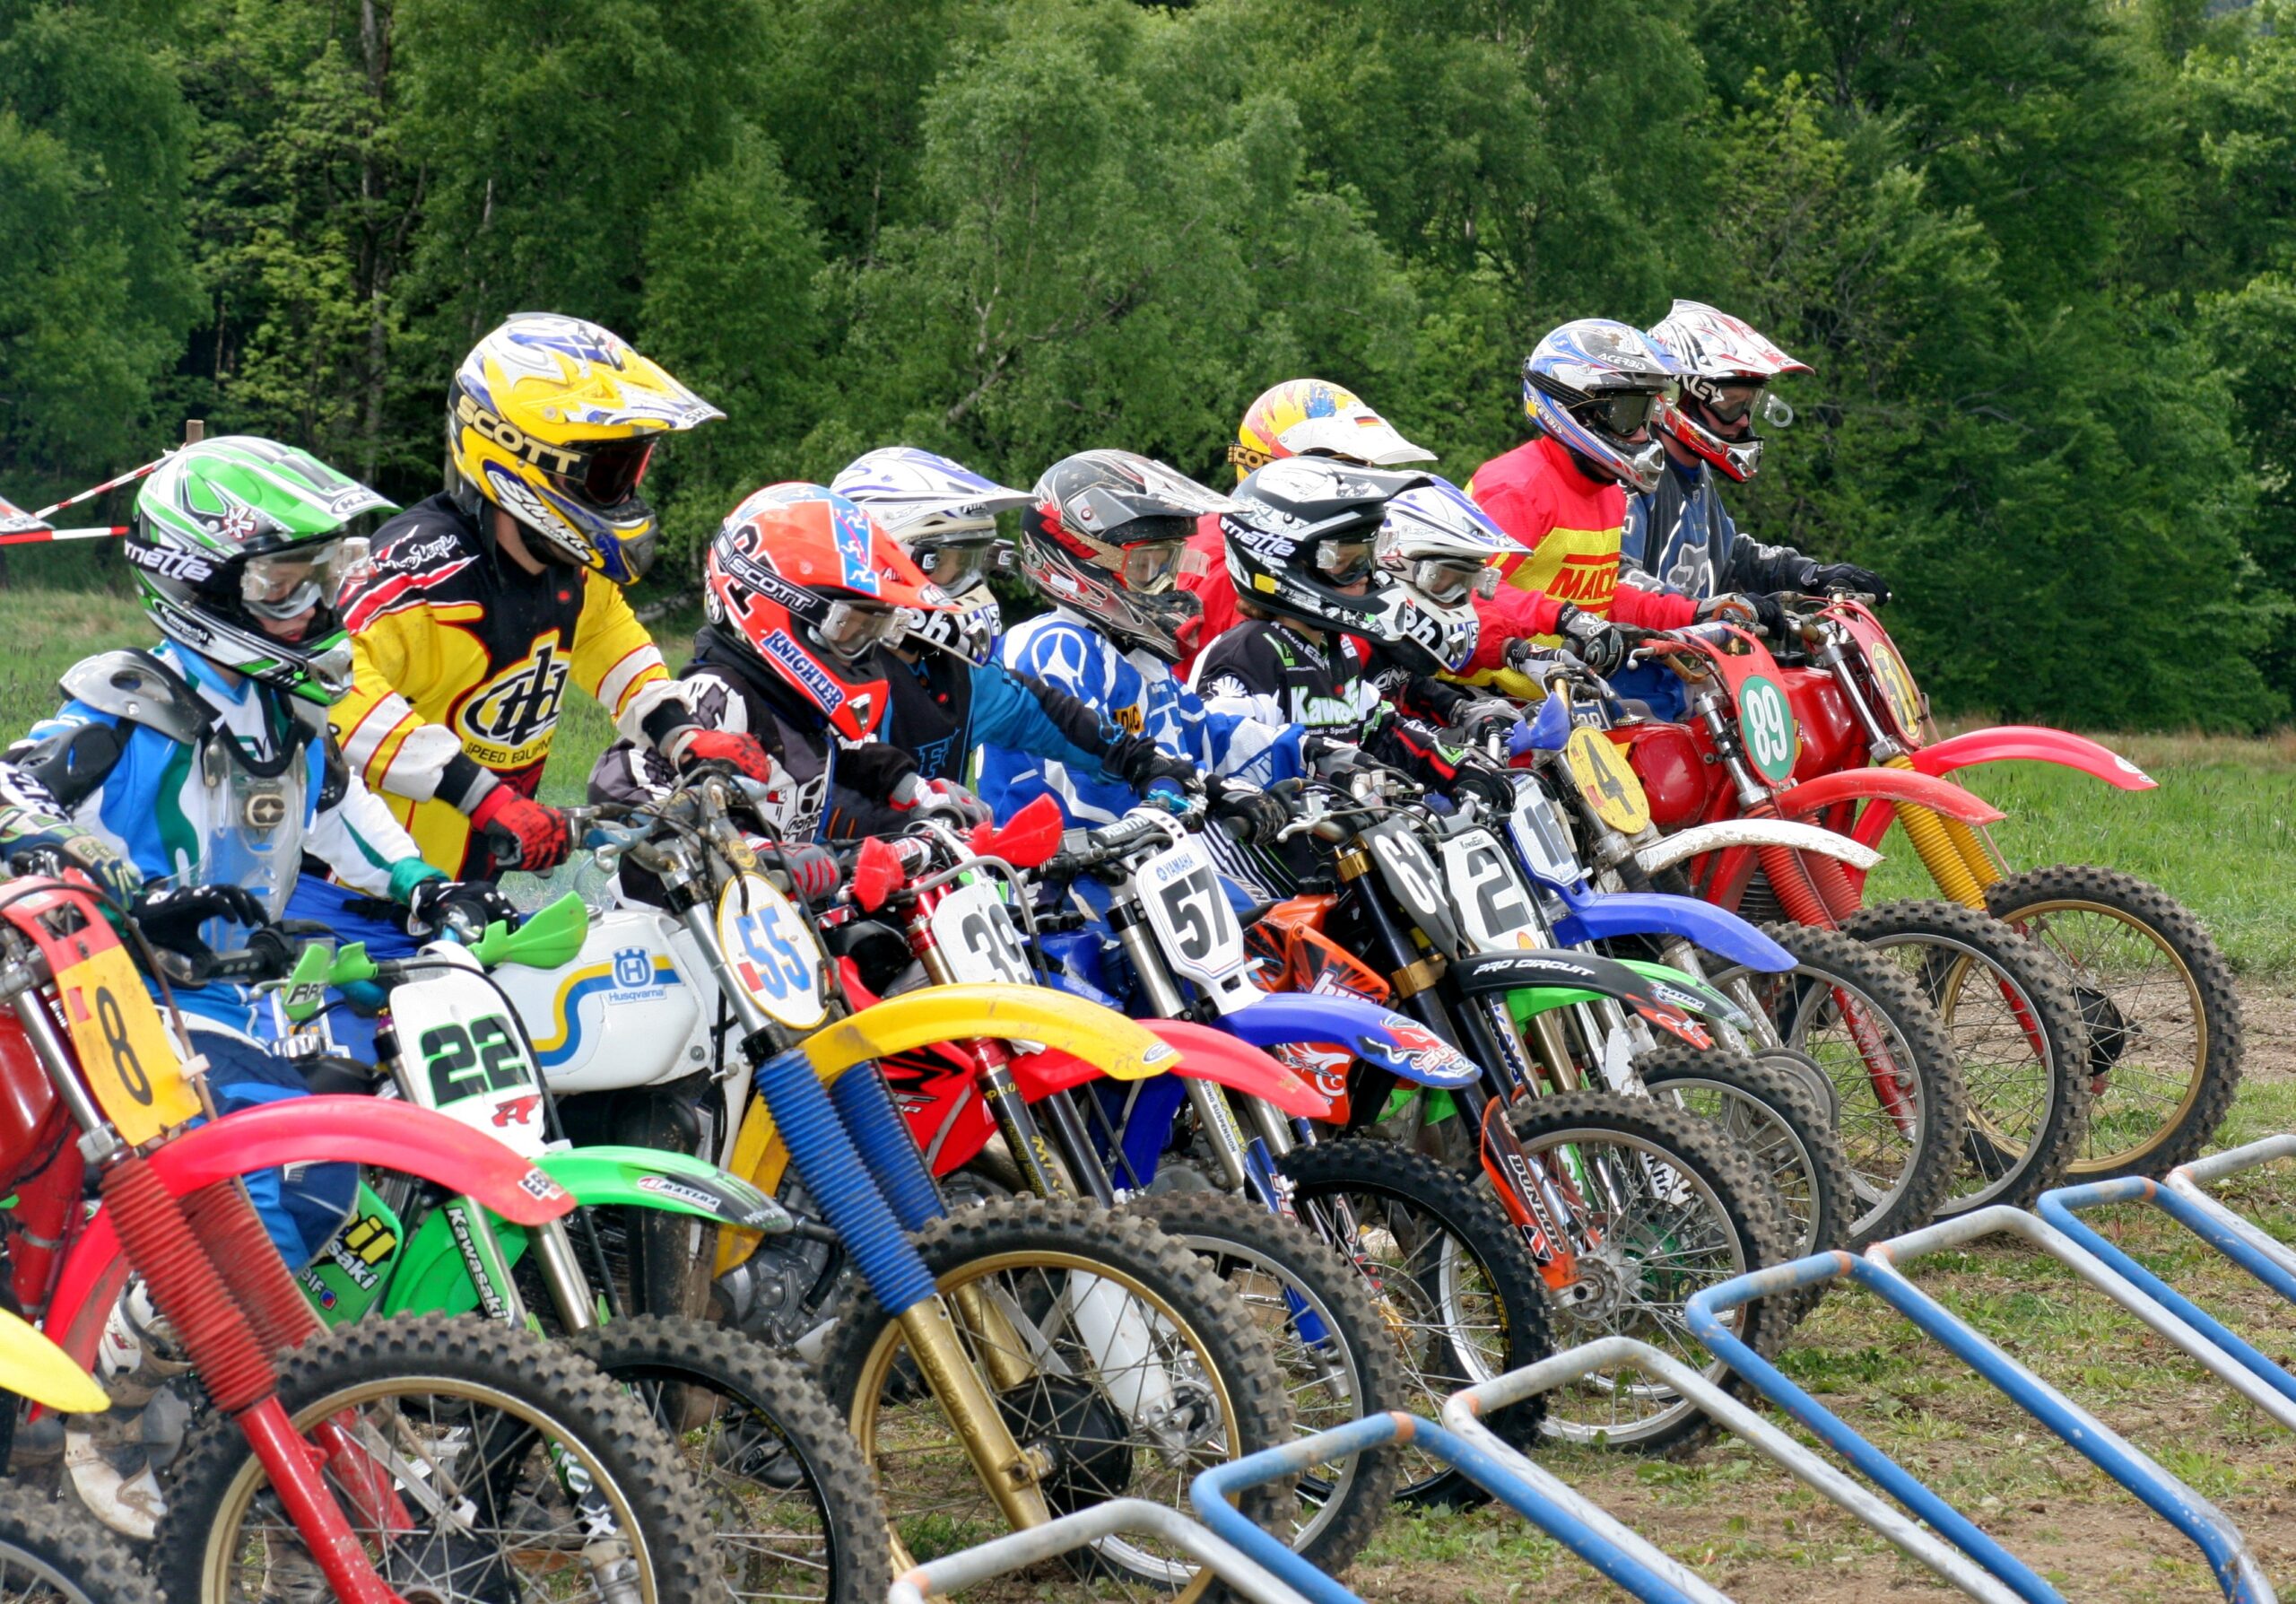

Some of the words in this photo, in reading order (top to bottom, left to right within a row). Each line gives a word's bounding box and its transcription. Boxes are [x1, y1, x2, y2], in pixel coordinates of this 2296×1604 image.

[457, 395, 581, 475] SCOTT
[124, 541, 213, 581] rnette
[1219, 516, 1296, 557] arnette
[728, 558, 811, 611] SCOTT
[1114, 705, 1141, 733] DAC
[1745, 686, 1787, 767] 89
[465, 742, 507, 763] SPEED
[1583, 735, 1635, 815] 4
[1163, 853, 1196, 877] YAMAHA
[1465, 847, 1531, 939] 2
[961, 902, 1032, 985] 39
[1158, 864, 1230, 961] 57
[735, 904, 812, 1000] 55
[1472, 960, 1509, 976] PRO
[1515, 959, 1596, 976] CIRCUIT
[608, 989, 664, 1003] Husqvarna
[95, 985, 153, 1106] 8
[420, 1013, 533, 1109] 22
[1213, 1103, 1237, 1153] SUSPENSION
[662, 1182, 721, 1207] MAXIMA
[1508, 1155, 1565, 1254] DUNLOP
[326, 1239, 378, 1291] saki
[447, 1206, 509, 1320] Kawasaki
